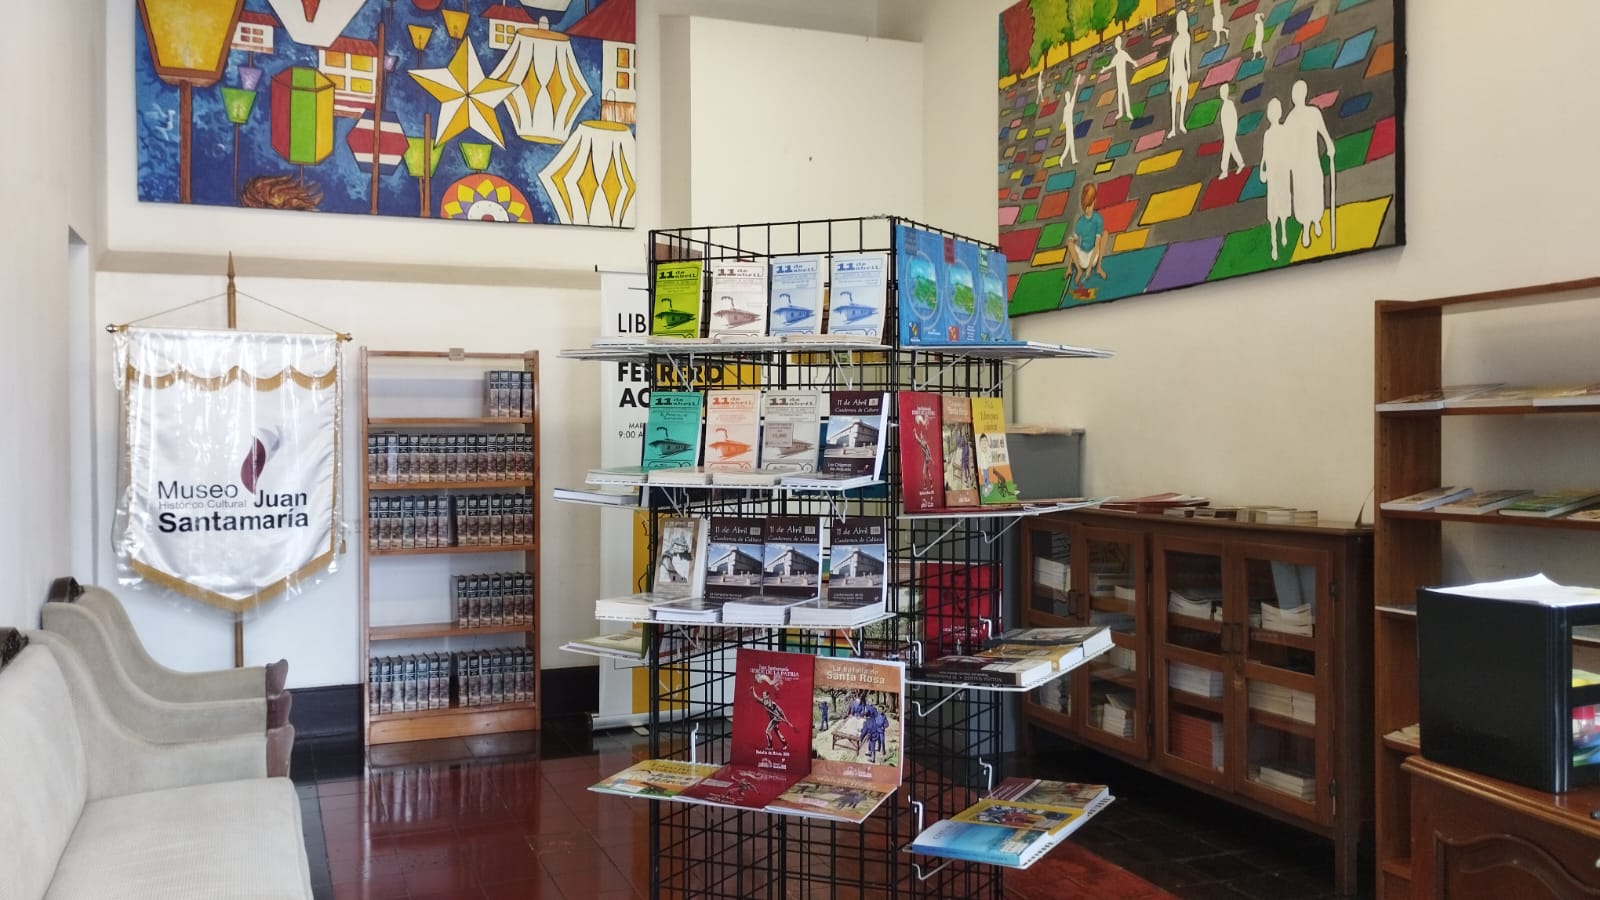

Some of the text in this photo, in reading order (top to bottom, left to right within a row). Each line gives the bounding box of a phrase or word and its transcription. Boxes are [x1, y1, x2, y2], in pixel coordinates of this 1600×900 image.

[776, 264, 793, 273] 11
[837, 262, 855, 271] 11
[659, 271, 674, 279] 11
[718, 268, 737, 277] 11
[618, 313, 647, 333] LIB
[618, 362, 723, 383] FERERO
[655, 397, 672, 406] 11
[712, 397, 729, 405] 11
[769, 398, 788, 406] 11
[618, 430, 636, 438] 9:00
[158, 480, 238, 500] Museo
[207, 499, 247, 509] Cultural
[253, 490, 307, 509] Juan
[158, 508, 309, 533] Santamaría
[732, 525, 748, 534] Abril
[786, 525, 802, 533] Abril
[852, 527, 868, 535] Abril
[826, 671, 885, 684] Santa Rosa
